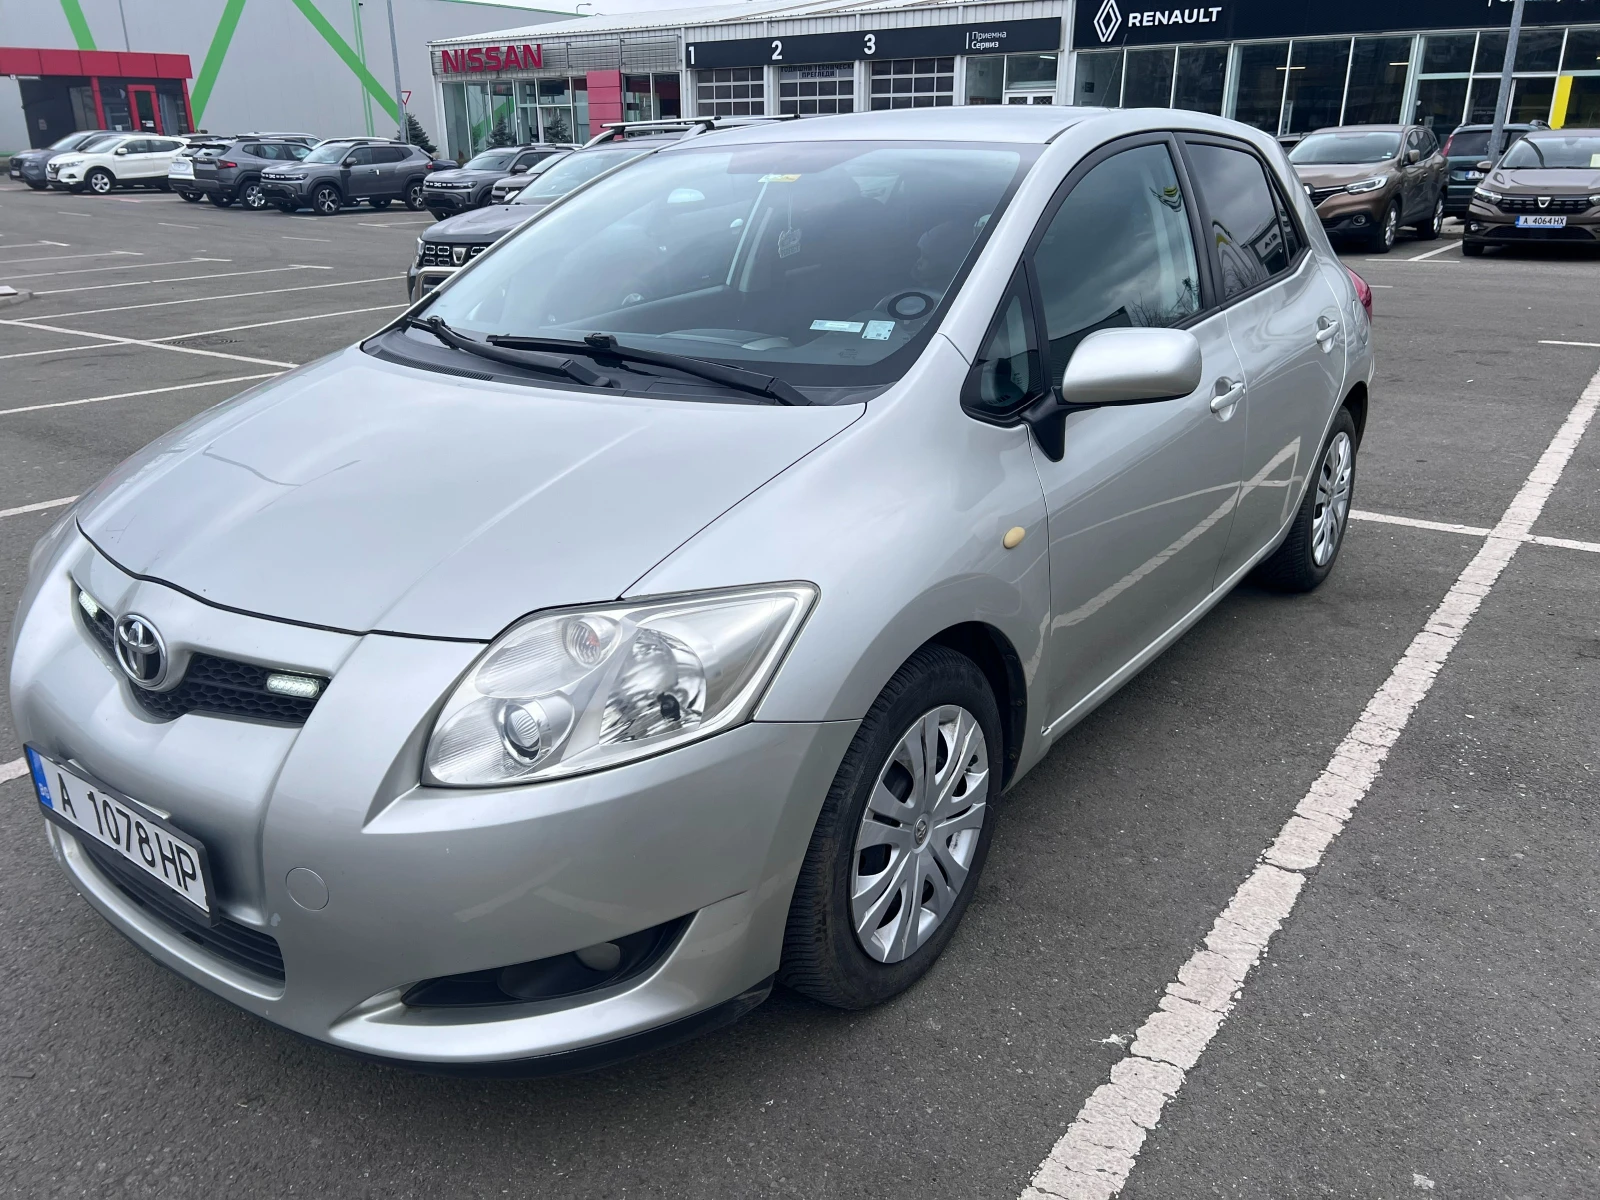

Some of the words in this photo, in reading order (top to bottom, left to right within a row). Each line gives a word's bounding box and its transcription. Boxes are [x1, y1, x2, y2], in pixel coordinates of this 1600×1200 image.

[1128, 7, 1222, 27] RENAULT
[863, 34, 876, 55] 3
[971, 31, 1007, 41] Приемна
[971, 41, 999, 50] Сервиз
[441, 43, 543, 74] NISSAN
[688, 46, 695, 65] 1
[771, 40, 783, 60] 2
[57, 772, 77, 819] A
[87, 790, 197, 892] 1078HP
